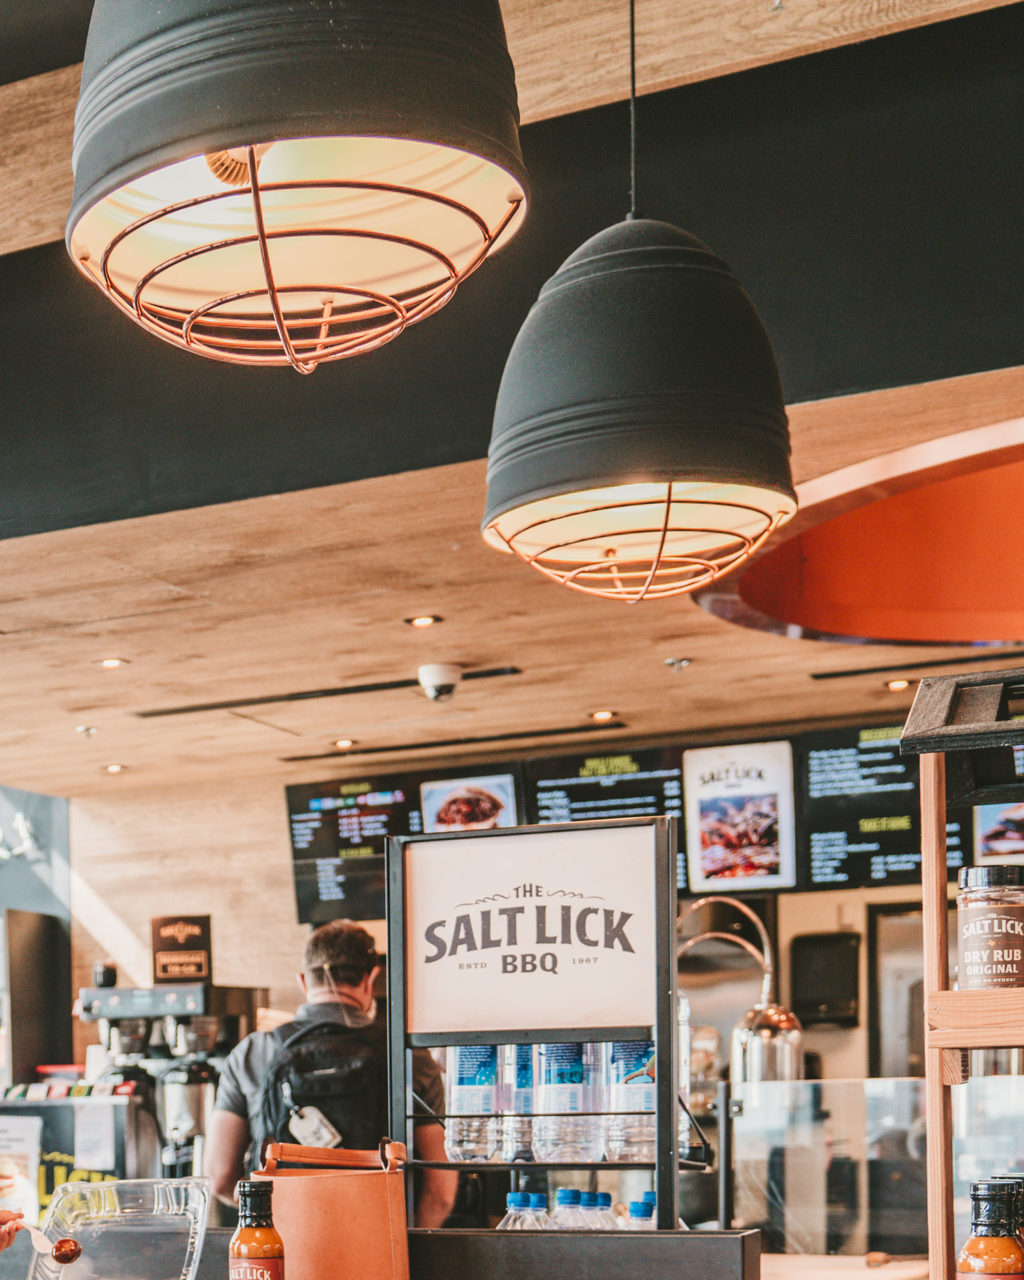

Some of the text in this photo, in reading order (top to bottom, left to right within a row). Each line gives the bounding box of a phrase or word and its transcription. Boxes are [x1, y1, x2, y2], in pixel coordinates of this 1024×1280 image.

[513, 883, 543, 898] THE
[424, 905, 636, 964] SALT LICK
[962, 919, 1024, 939] SALT LICK
[458, 952, 599, 975] ESTD BBQ 1967
[964, 949, 1022, 963] DRY RUB
[966, 964, 1019, 976] ORIGINAL
[230, 1268, 245, 1280] ALT
